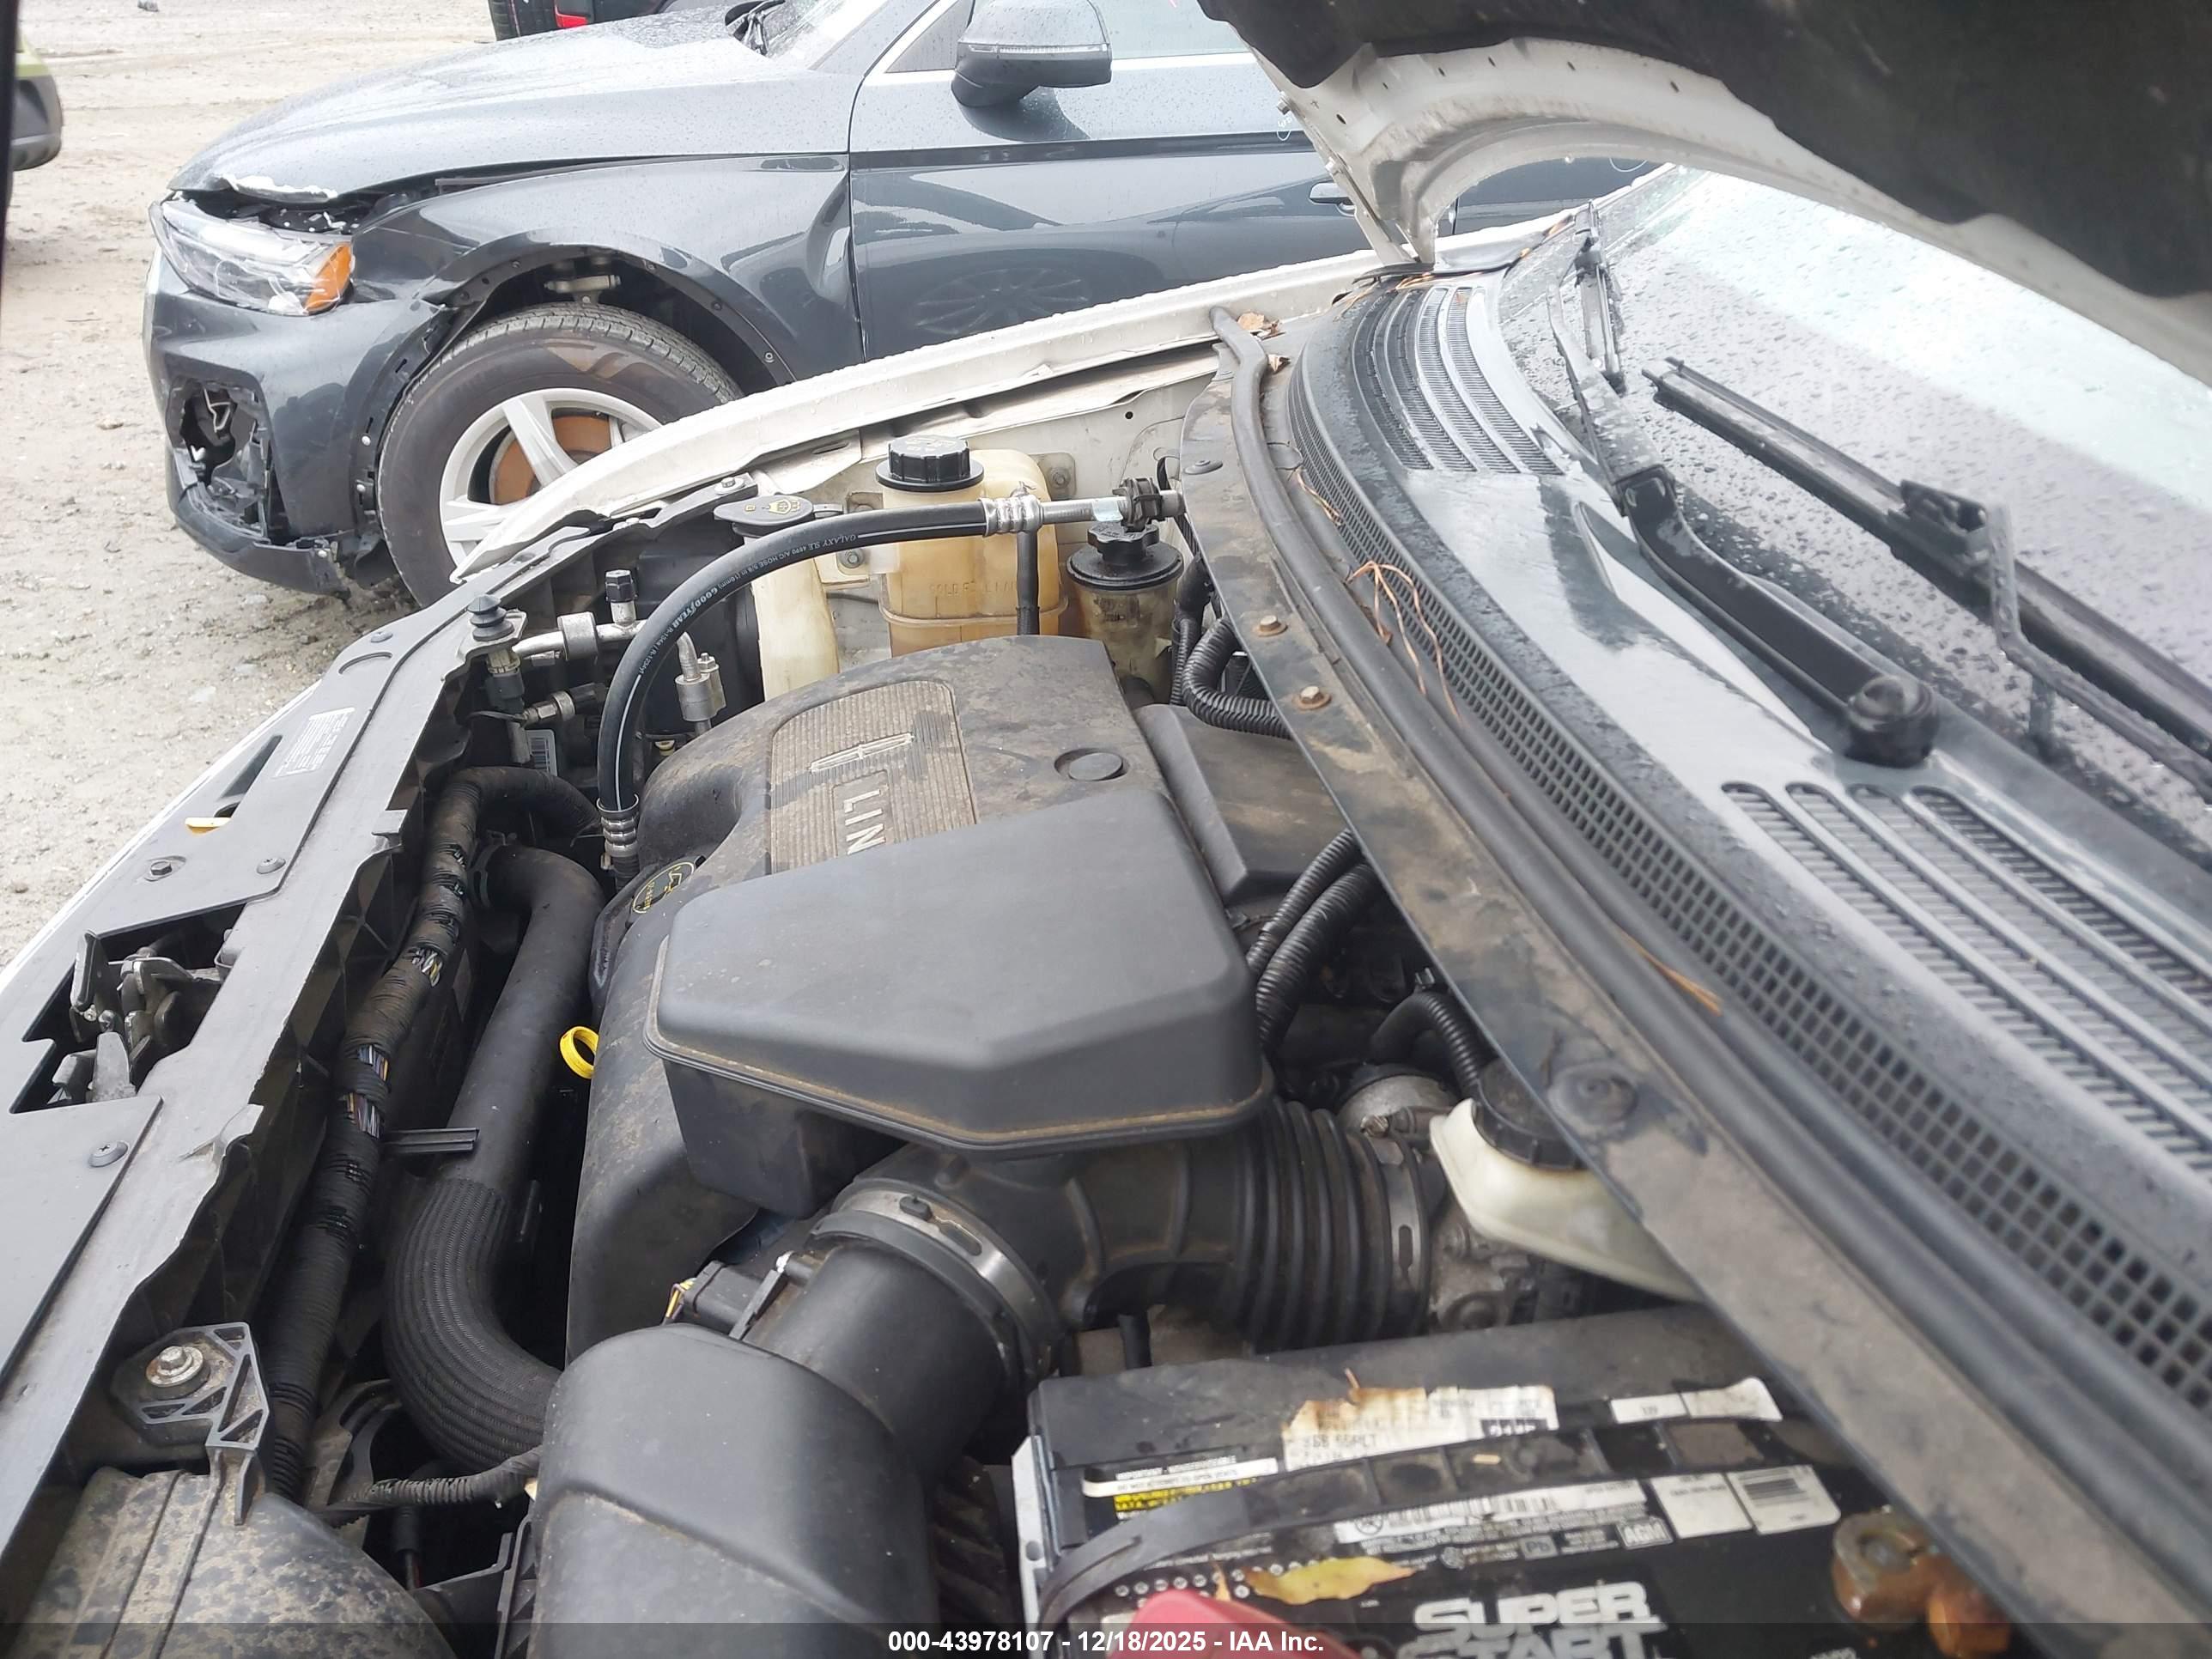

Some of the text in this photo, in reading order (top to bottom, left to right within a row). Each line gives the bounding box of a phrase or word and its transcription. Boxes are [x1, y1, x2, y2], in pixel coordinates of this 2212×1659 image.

[823, 534, 856, 546] GALAXY
[759, 556, 778, 567] HOSE
[780, 550, 791, 559] A/C
[672, 587, 718, 628] GOODYEAR
[1623, 1519, 1668, 1546] AGM
[1526, 1539, 1547, 1553] Pb
[1413, 1581, 1650, 1642] SUPER
[1396, 1615, 1668, 1659] START
